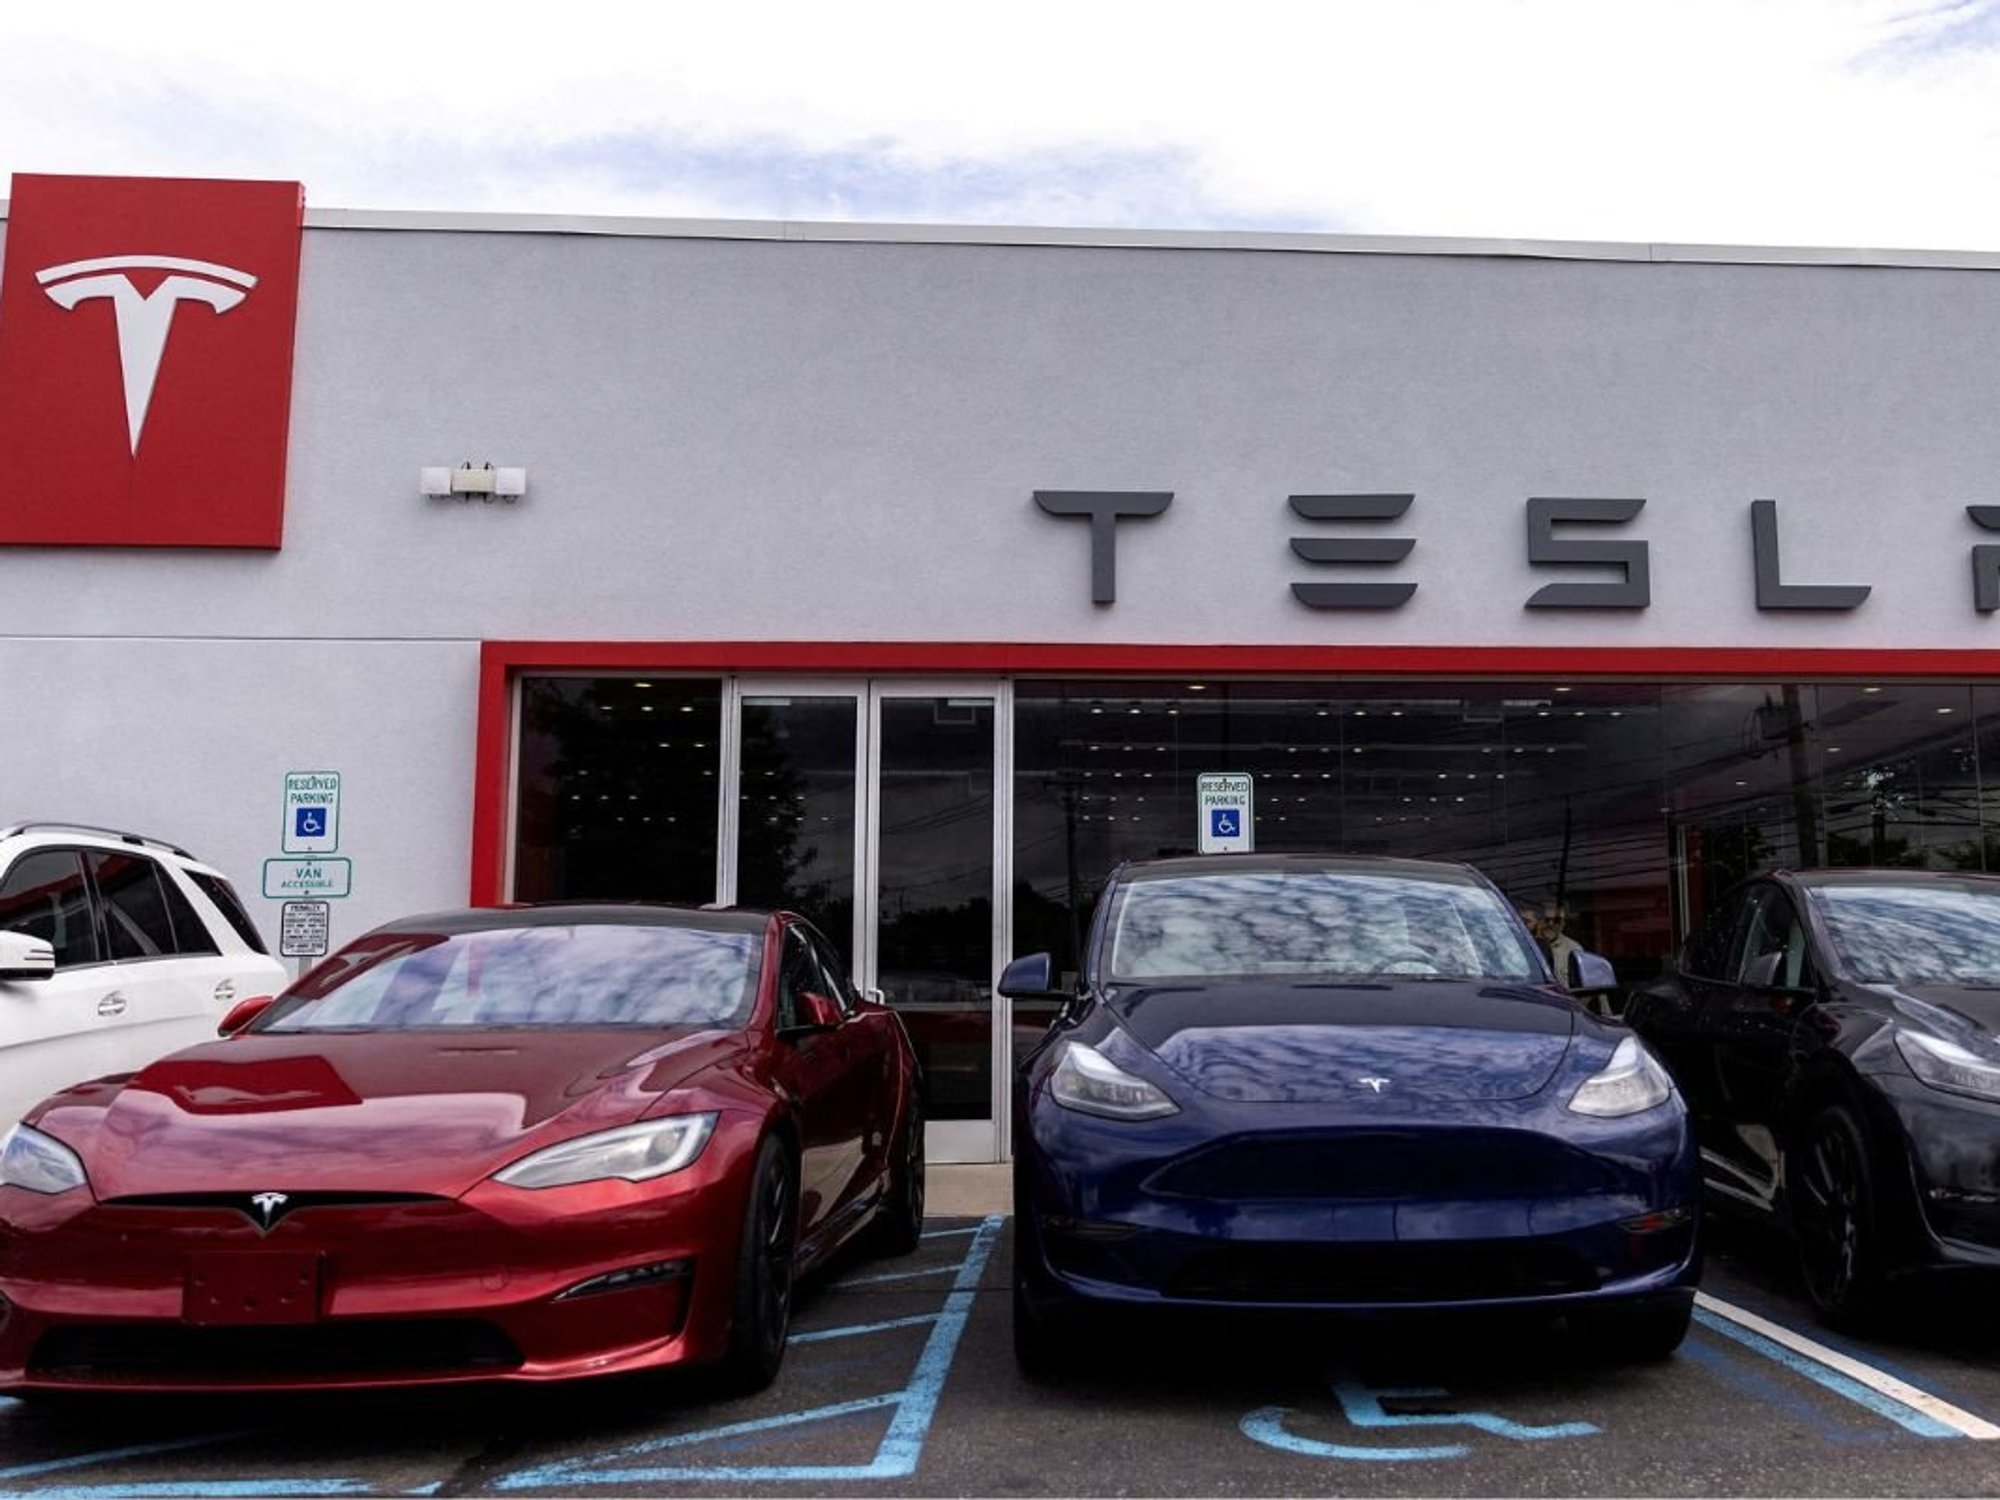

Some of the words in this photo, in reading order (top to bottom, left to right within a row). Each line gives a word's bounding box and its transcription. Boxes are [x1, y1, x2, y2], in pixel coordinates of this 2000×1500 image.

[287, 778, 337, 790] RESERVED
[1201, 781, 1248, 792] RESERVED
[290, 792, 333, 803] PARKING
[1205, 795, 1245, 805] PARKING
[296, 868, 322, 878] VAN
